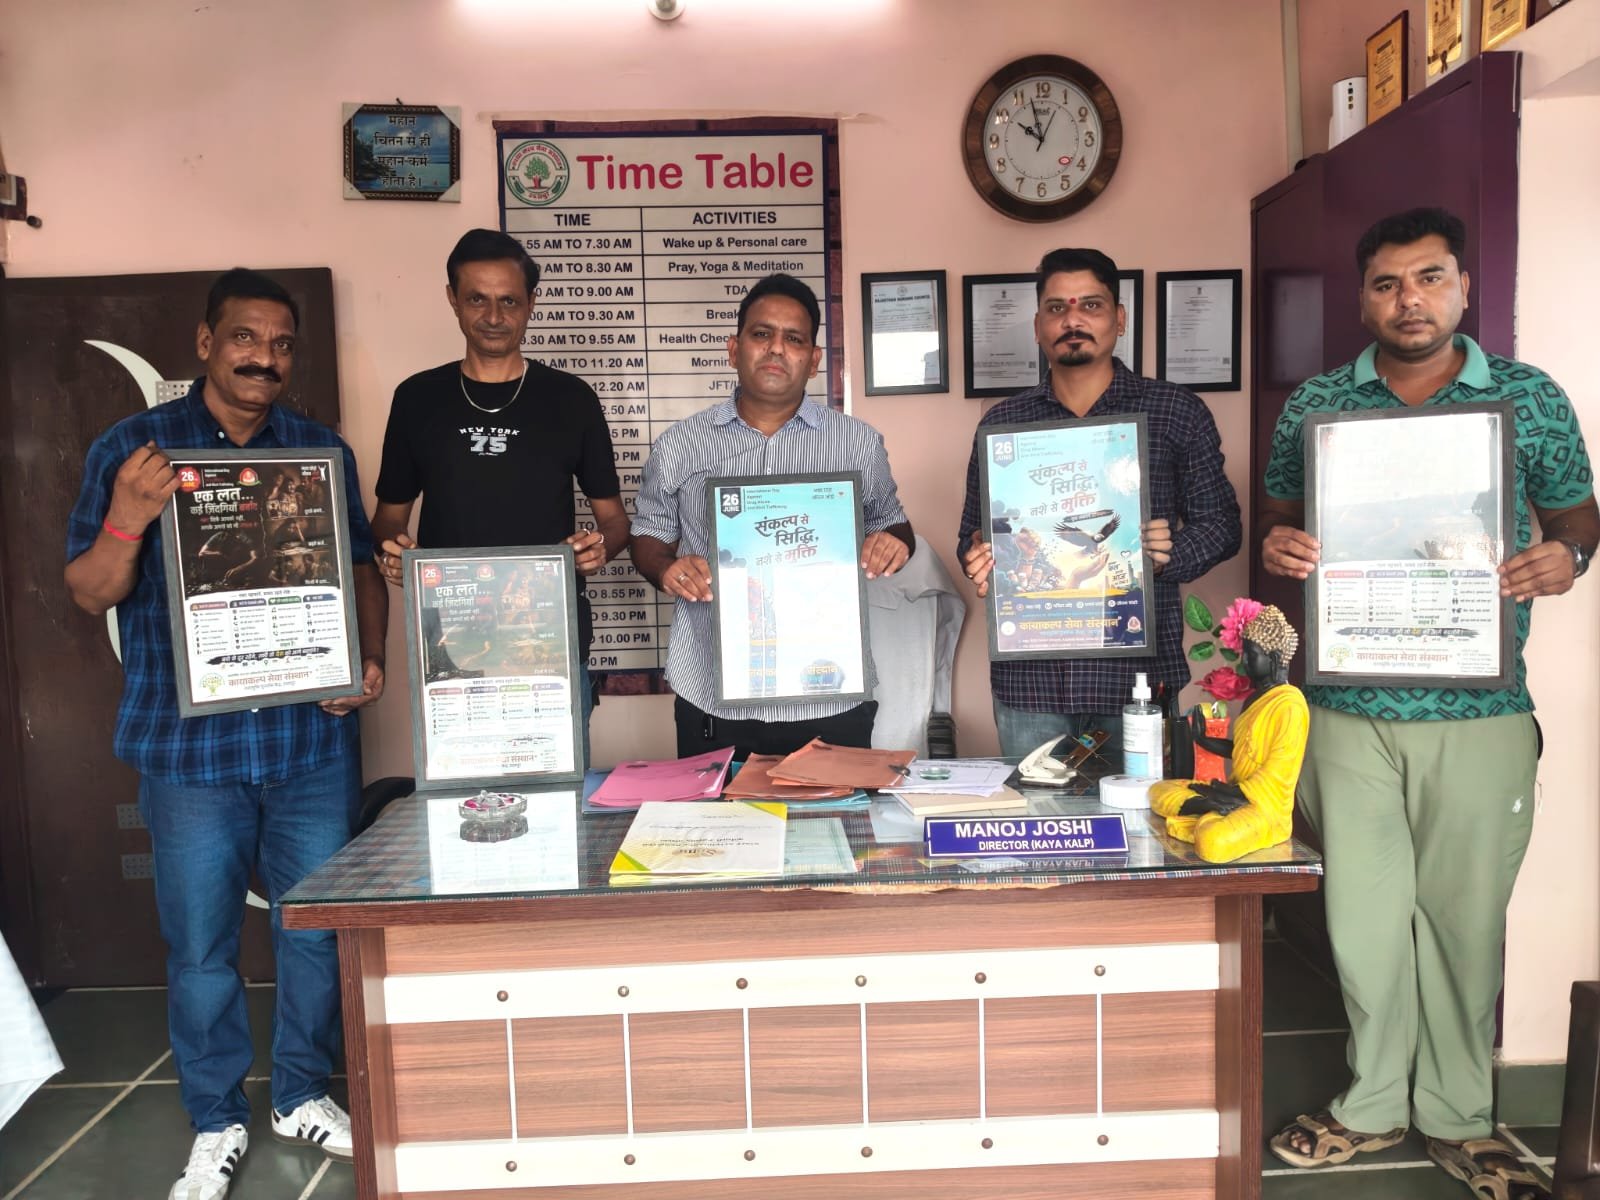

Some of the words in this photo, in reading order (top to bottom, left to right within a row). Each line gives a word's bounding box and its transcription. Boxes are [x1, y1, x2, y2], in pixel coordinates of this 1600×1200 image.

[1036, 82, 1050, 98] 12
[1012, 90, 1024, 105] 11
[1062, 89, 1068, 104] 1
[995, 108, 1009, 124] 10
[1078, 106, 1088, 122] 2
[990, 133, 999, 149] 9
[1084, 131, 1094, 148] 3
[996, 157, 1006, 173] 8
[1077, 156, 1086, 171] 4
[576, 155, 683, 190] Time
[695, 152, 814, 189] Table
[1016, 177, 1025, 192] 7
[1060, 175, 1070, 190] 5
[1037, 182, 1046, 198] 6
[554, 213, 591, 226] TIME
[693, 212, 777, 224] ACTIVITIES
[519, 239, 541, 250] .55
[544, 240, 562, 249] AM
[565, 239, 582, 249] TO
[586, 238, 610, 249] 7.30
[614, 238, 632, 248] AM
[662, 238, 694, 248] Wake
[698, 239, 712, 250] up
[716, 238, 724, 248] &
[728, 236, 778, 248] Personal
[781, 238, 808, 246] care
[544, 264, 563, 273] AM
[566, 263, 582, 273] TO
[586, 262, 611, 273] 8.30
[614, 262, 632, 272] AM
[668, 262, 698, 274] Pray,
[700, 262, 728, 273] Yoga
[732, 261, 740, 270] &
[744, 260, 804, 271] Meditation
[546, 288, 564, 297] AM
[567, 287, 584, 296] TO
[587, 286, 612, 296] 9.00
[616, 286, 634, 296] AM
[546, 311, 565, 320] AM
[568, 310, 584, 320] TO
[588, 310, 613, 320] 9.30
[616, 310, 634, 320] AM
[706, 310, 739, 320] Break
[548, 335, 566, 344] AM
[570, 334, 586, 344] TO
[589, 334, 614, 344] 9.55
[618, 334, 636, 344] AM
[659, 334, 696, 344] Health
[700, 333, 733, 343] Chec
[550, 359, 568, 368] AM
[570, 358, 588, 368] TO
[591, 358, 622, 368] 11.20
[626, 358, 644, 368] AM
[592, 382, 624, 392] 12.20
[626, 382, 645, 392] AM
[600, 405, 624, 415] 2.50
[628, 405, 646, 415] AM
[459, 426, 484, 434] NEW
[490, 427, 520, 436] YORK
[622, 428, 638, 438] PM
[470, 434, 508, 453] 75
[994, 442, 1012, 454] 26
[622, 452, 640, 462] PM
[181, 472, 194, 482] 26
[1028, 461, 1076, 486] संकल्प
[1078, 460, 1088, 472] से
[624, 475, 640, 484] PM
[193, 490, 214, 503] एक
[722, 494, 739, 506] 26
[1030, 502, 1047, 517] नशे
[1050, 502, 1058, 513] से
[1060, 491, 1097, 514] मुक्ति
[578, 522, 594, 531] TO
[754, 515, 798, 538] संकल्प
[800, 513, 809, 525] से
[424, 568, 436, 578] 26
[600, 566, 624, 576] 8.30
[436, 586, 454, 598] एक
[586, 590, 598, 599] O
[600, 589, 626, 598] 8.55
[628, 588, 646, 598] PM
[602, 612, 626, 621] 9.30
[629, 611, 646, 620] PM
[598, 634, 630, 644] 10.00
[633, 633, 650, 642] PM
[600, 656, 618, 666] PM
[955, 822, 1026, 838] MANOJ
[1032, 820, 1092, 836] JOSHI
[978, 840, 1029, 850] DIRECTOR
[1031, 838, 1062, 850] (KAYA
[1064, 838, 1095, 849] KALP)
